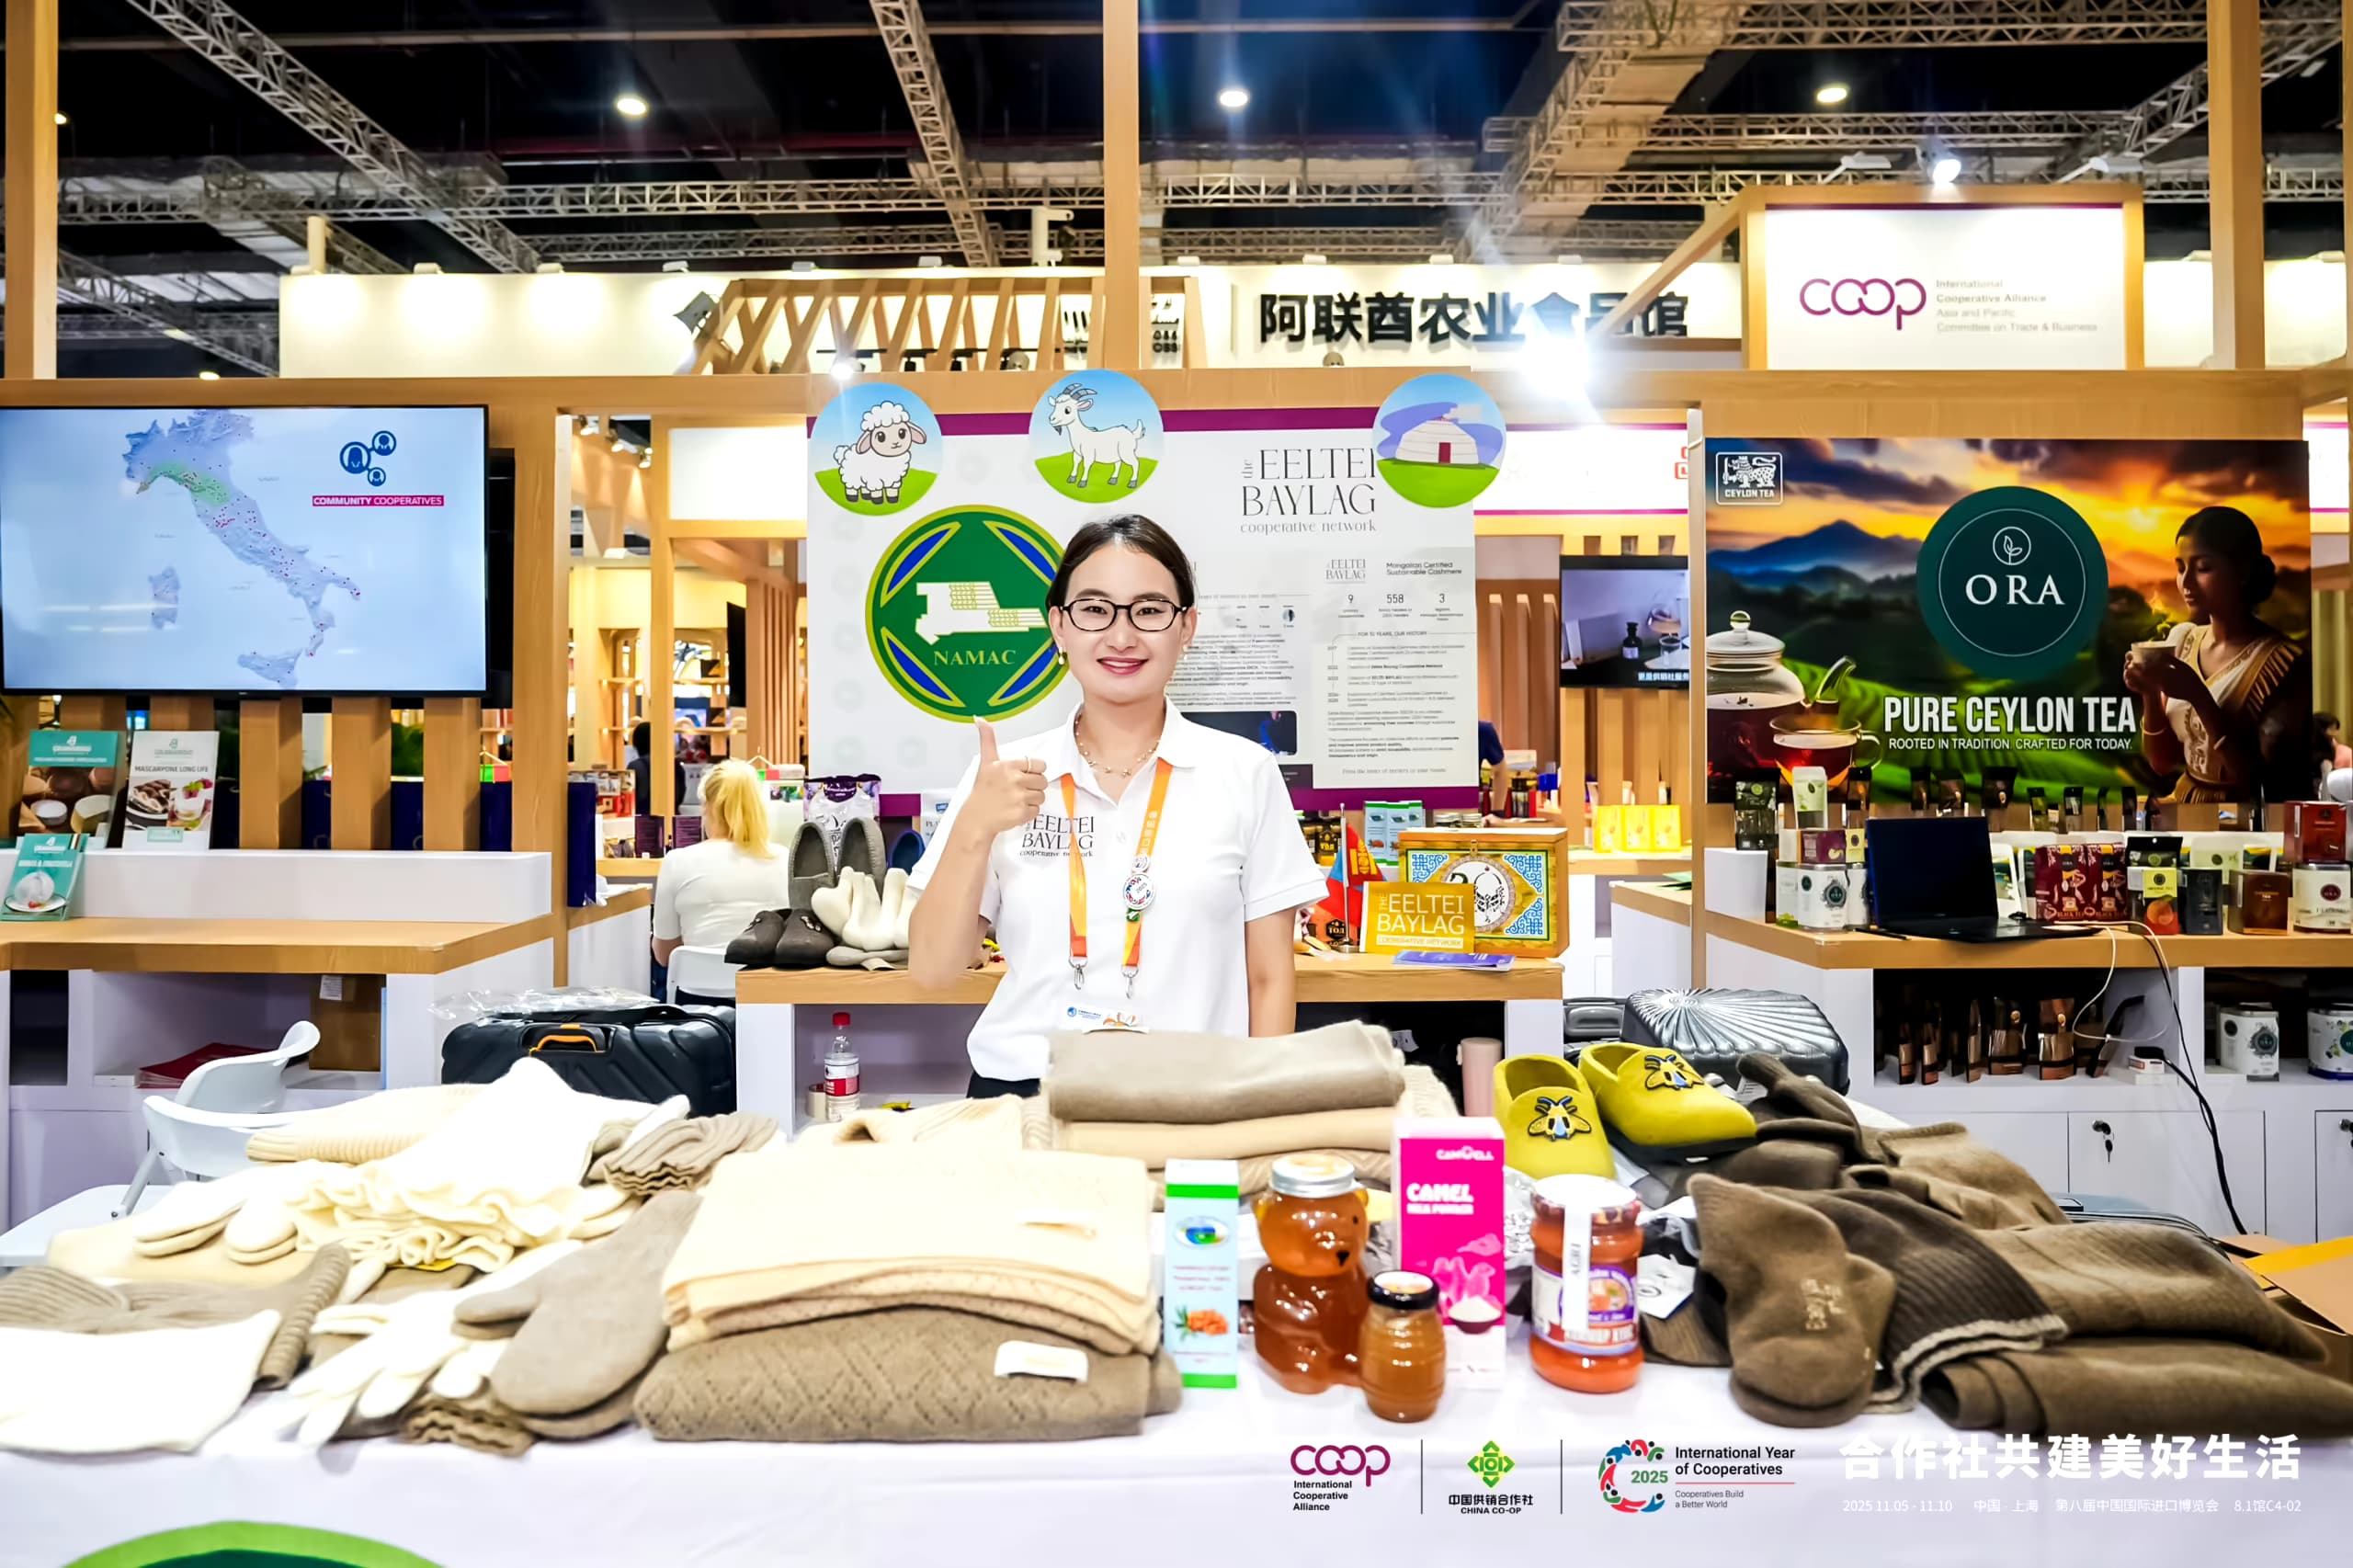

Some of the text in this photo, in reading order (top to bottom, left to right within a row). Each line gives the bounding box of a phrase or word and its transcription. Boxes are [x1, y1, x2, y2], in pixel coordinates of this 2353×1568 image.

[1936, 279, 2003, 289] International
[1936, 293, 2047, 304] Cooperative Alliance
[1260, 448, 1376, 480] EELTEI
[313, 496, 442, 506] COMMUNITY COOPERATIVES
[1242, 483, 1376, 516] BAYLAG
[1724, 489, 1775, 498] CEYLON TEA
[1240, 519, 1376, 536] cooperative network
[1965, 574, 2065, 605] ORA
[1347, 594, 1354, 604] 9
[1386, 594, 1404, 604] 558
[1439, 593, 1445, 603] 3
[934, 649, 1016, 665] NAMAC
[1885, 697, 2136, 733] PURE CEYLON TEA
[1889, 738, 1936, 750] ROOTED
[1938, 738, 1949, 750] IN
[2015, 738, 2066, 750] CRAFTED
[2070, 738, 2092, 750] FOR
[2095, 738, 2132, 750] TODAY.
[134, 765, 178, 773] MASCARPONE
[1033, 814, 1095, 834] EELTEI
[1389, 893, 1464, 915] EELTEI
[1377, 914, 1464, 935] BAYLAG
[1405, 1183, 1474, 1203] CAMEL
